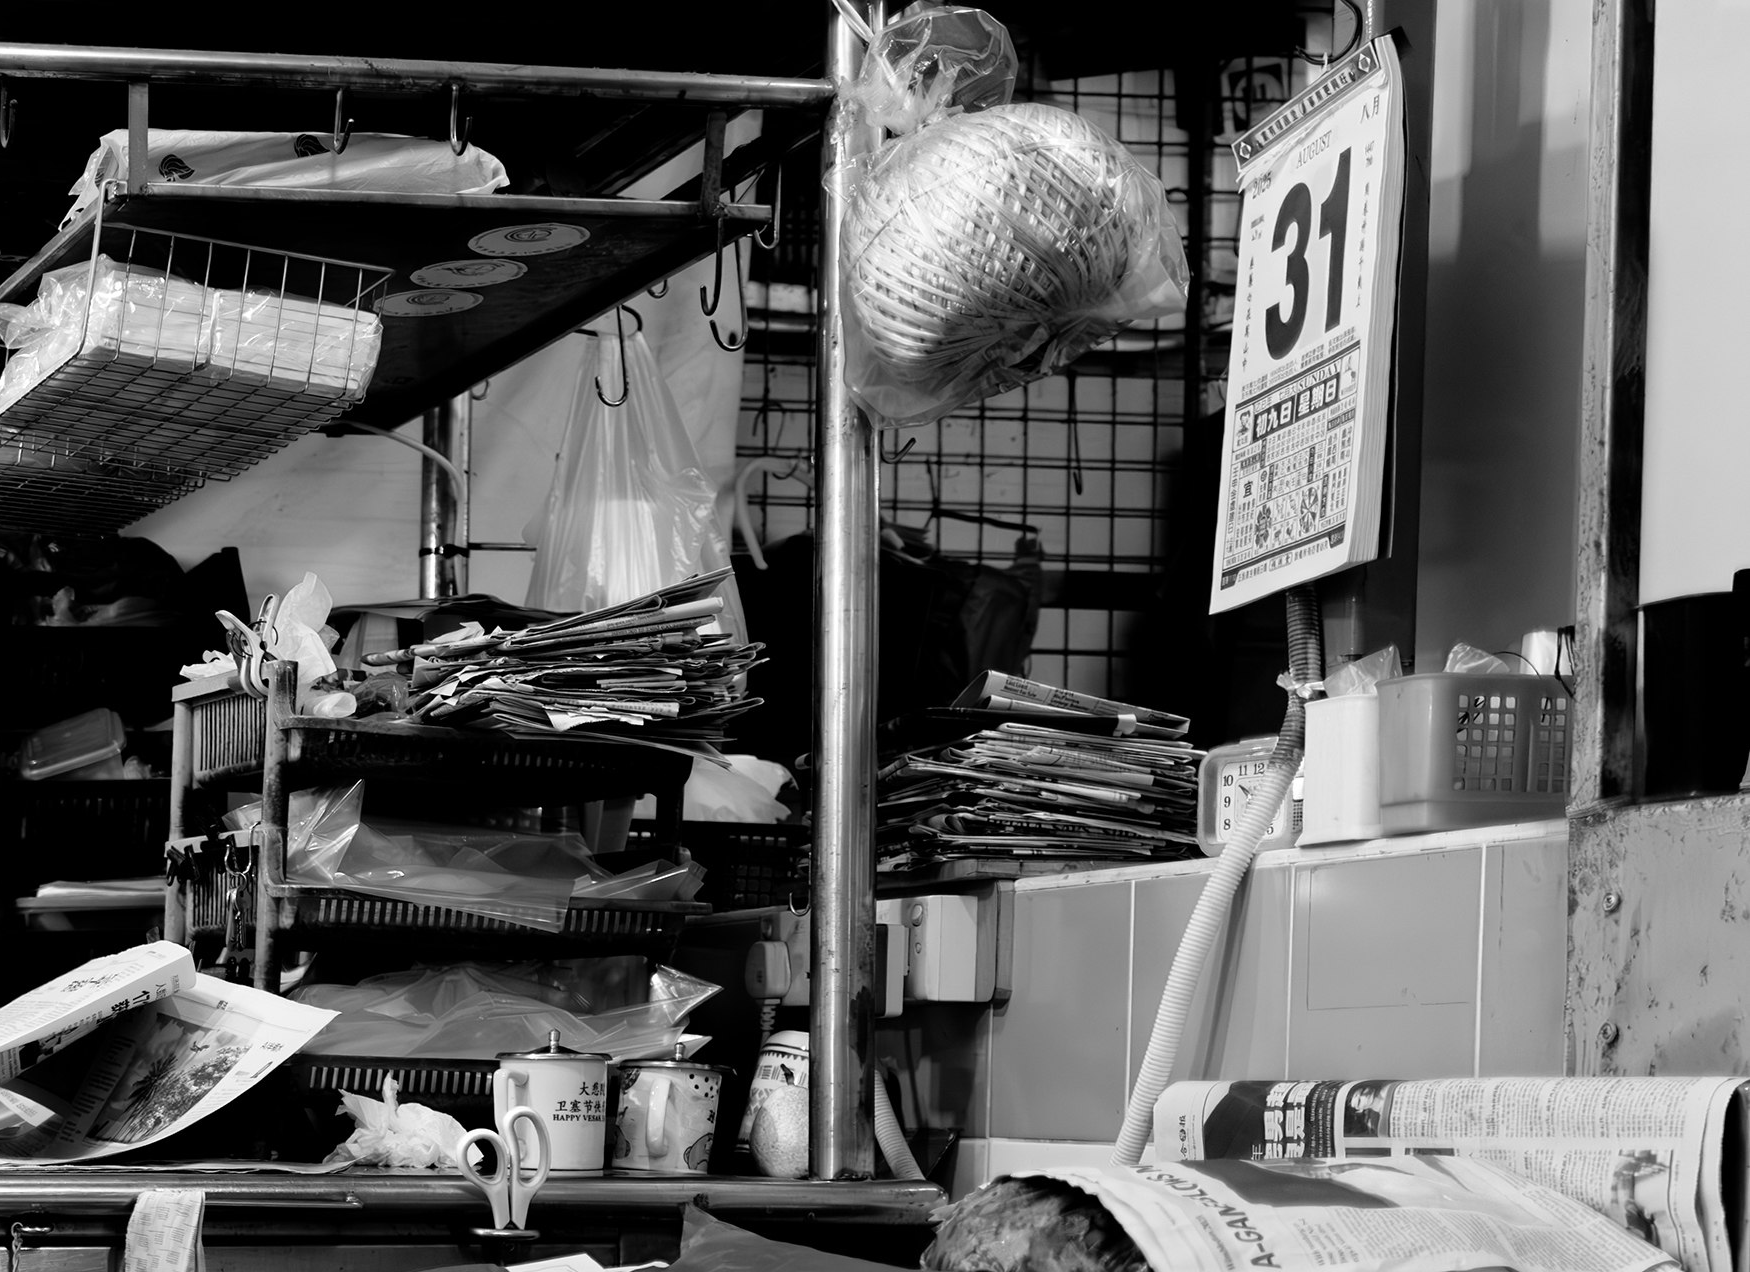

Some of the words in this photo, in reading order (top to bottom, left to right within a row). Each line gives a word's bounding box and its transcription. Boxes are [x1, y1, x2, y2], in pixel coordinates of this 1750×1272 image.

[1360, 94, 1380, 123] 八月
[1296, 130, 1332, 169] AUGUST
[1252, 171, 1272, 200] 2025
[1265, 146, 1353, 362] 31
[1298, 362, 1341, 391] SUNDAY
[1298, 377, 1337, 417] 星期日
[1256, 400, 1292, 438] 初九日
[1243, 480, 1254, 499] 宜
[1223, 774, 1234, 787] 10
[1238, 764, 1248, 776] 11
[1253, 762, 1265, 775] 12
[1224, 796, 1231, 808] 9
[1223, 818, 1231, 831] 8
[552, 1113, 582, 1122] HAPPY
[1250, 1143, 1264, 1161] 年
